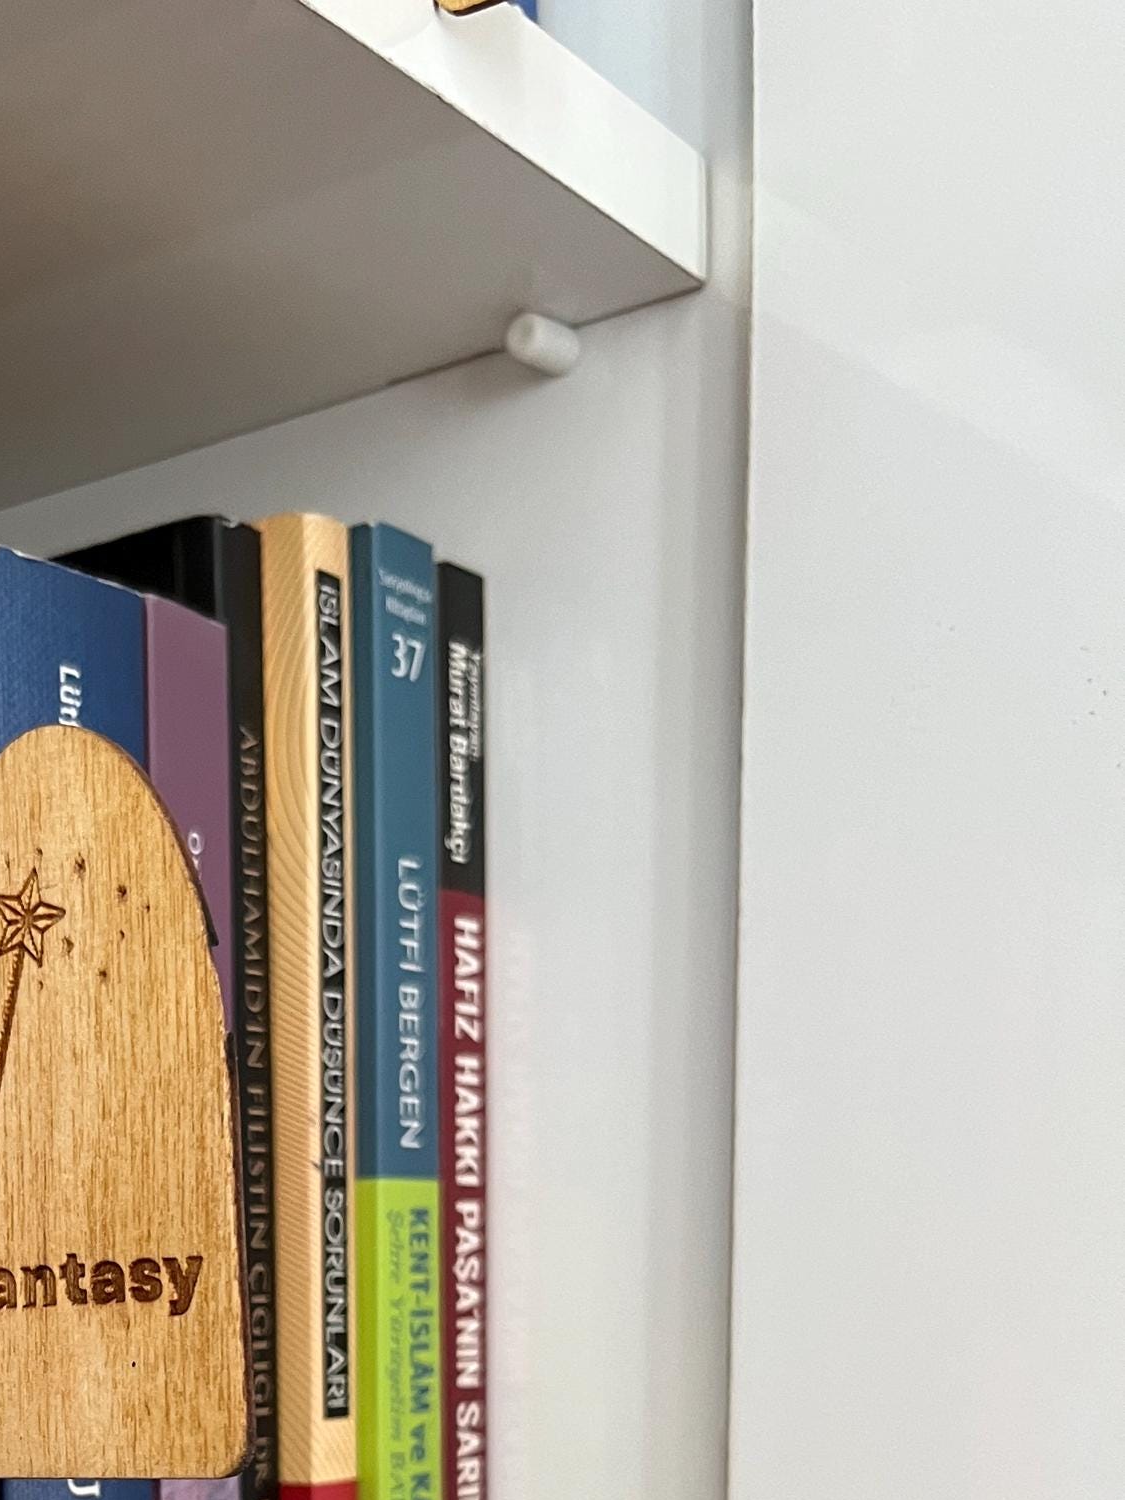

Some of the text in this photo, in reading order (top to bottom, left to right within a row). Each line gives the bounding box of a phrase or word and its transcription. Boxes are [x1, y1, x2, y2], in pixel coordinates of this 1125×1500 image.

[391, 632, 426, 683] 37
[446, 640, 472, 865] Murat Bardakçı
[320, 718, 346, 977] DÜNYASINDA
[396, 856, 426, 1151] LÜTFİ BERGEN
[453, 915, 483, 1044] HAFIZ
[322, 990, 348, 1177] DÜŞÜNCE
[454, 1054, 485, 1184] HAKKI
[324, 1186, 350, 1412] SORUNLARI
[412, 1423, 431, 1463] ve
